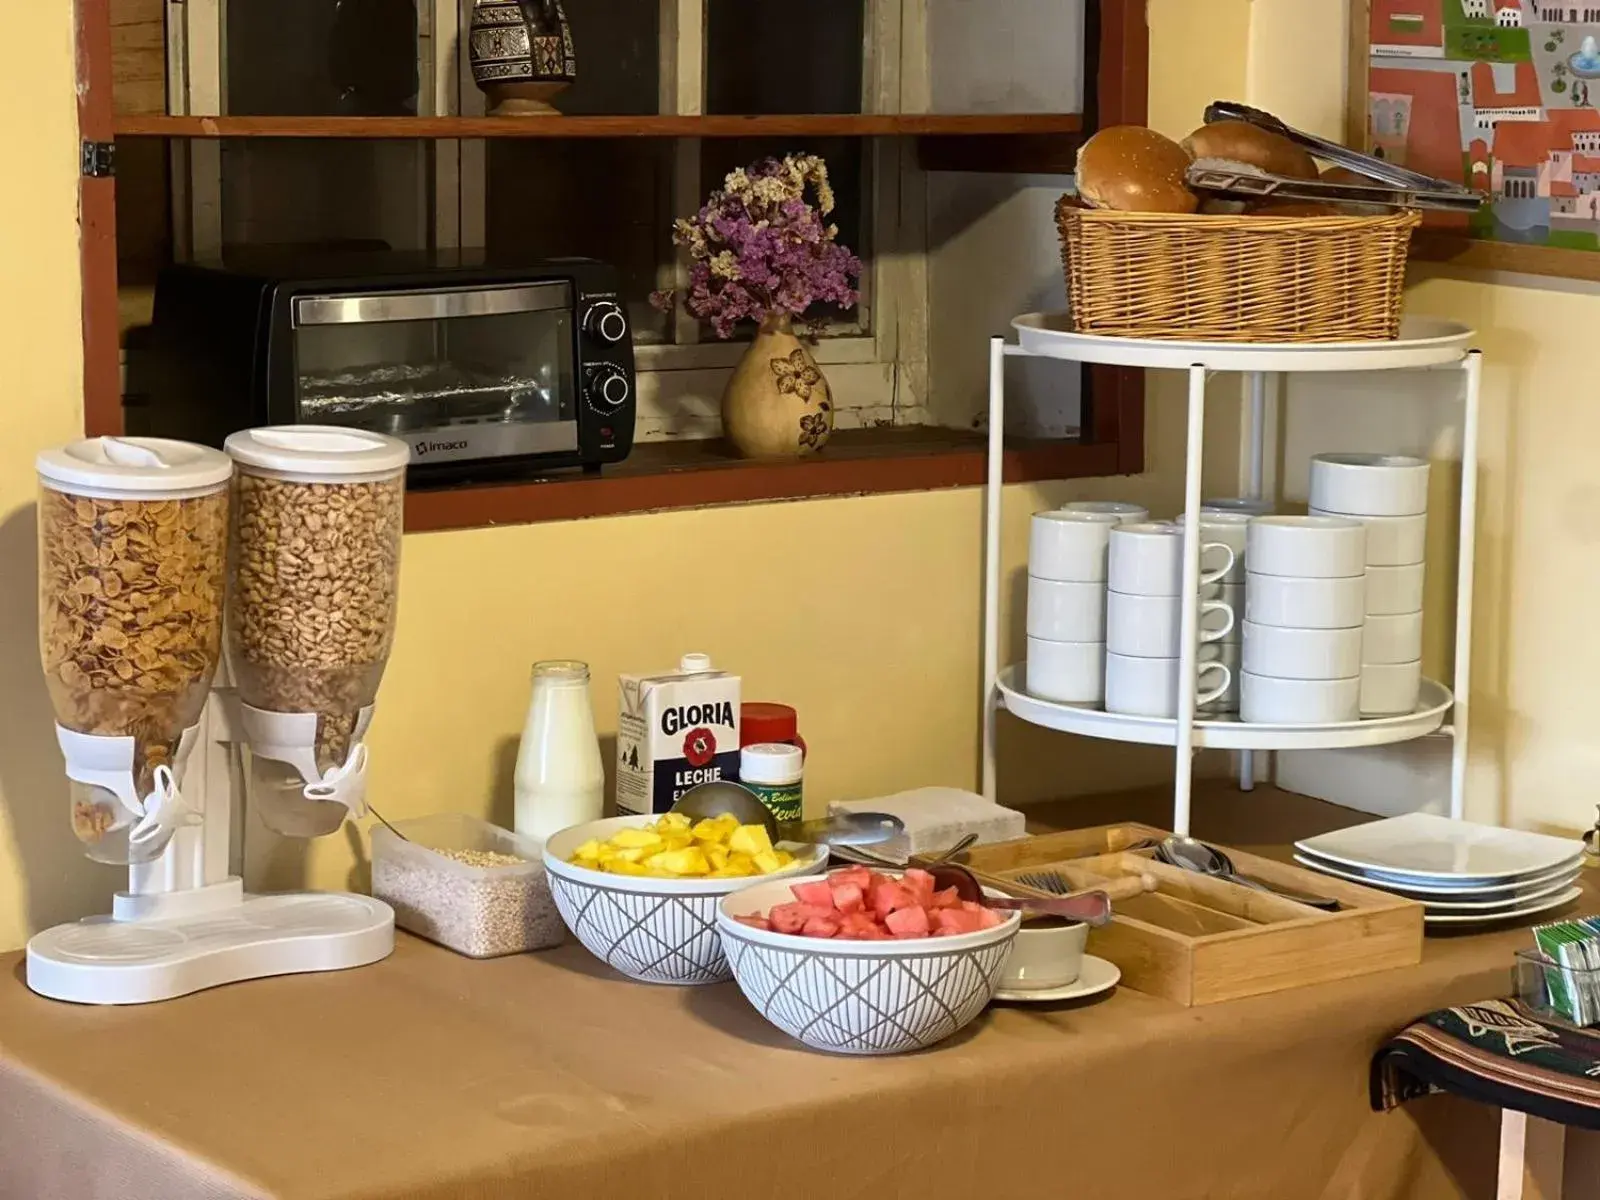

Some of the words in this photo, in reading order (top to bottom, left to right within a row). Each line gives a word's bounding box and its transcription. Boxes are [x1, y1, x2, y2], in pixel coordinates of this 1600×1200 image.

[429, 440, 468, 452] imaco
[661, 701, 735, 736] GLORIA
[675, 767, 721, 786] LECHE
